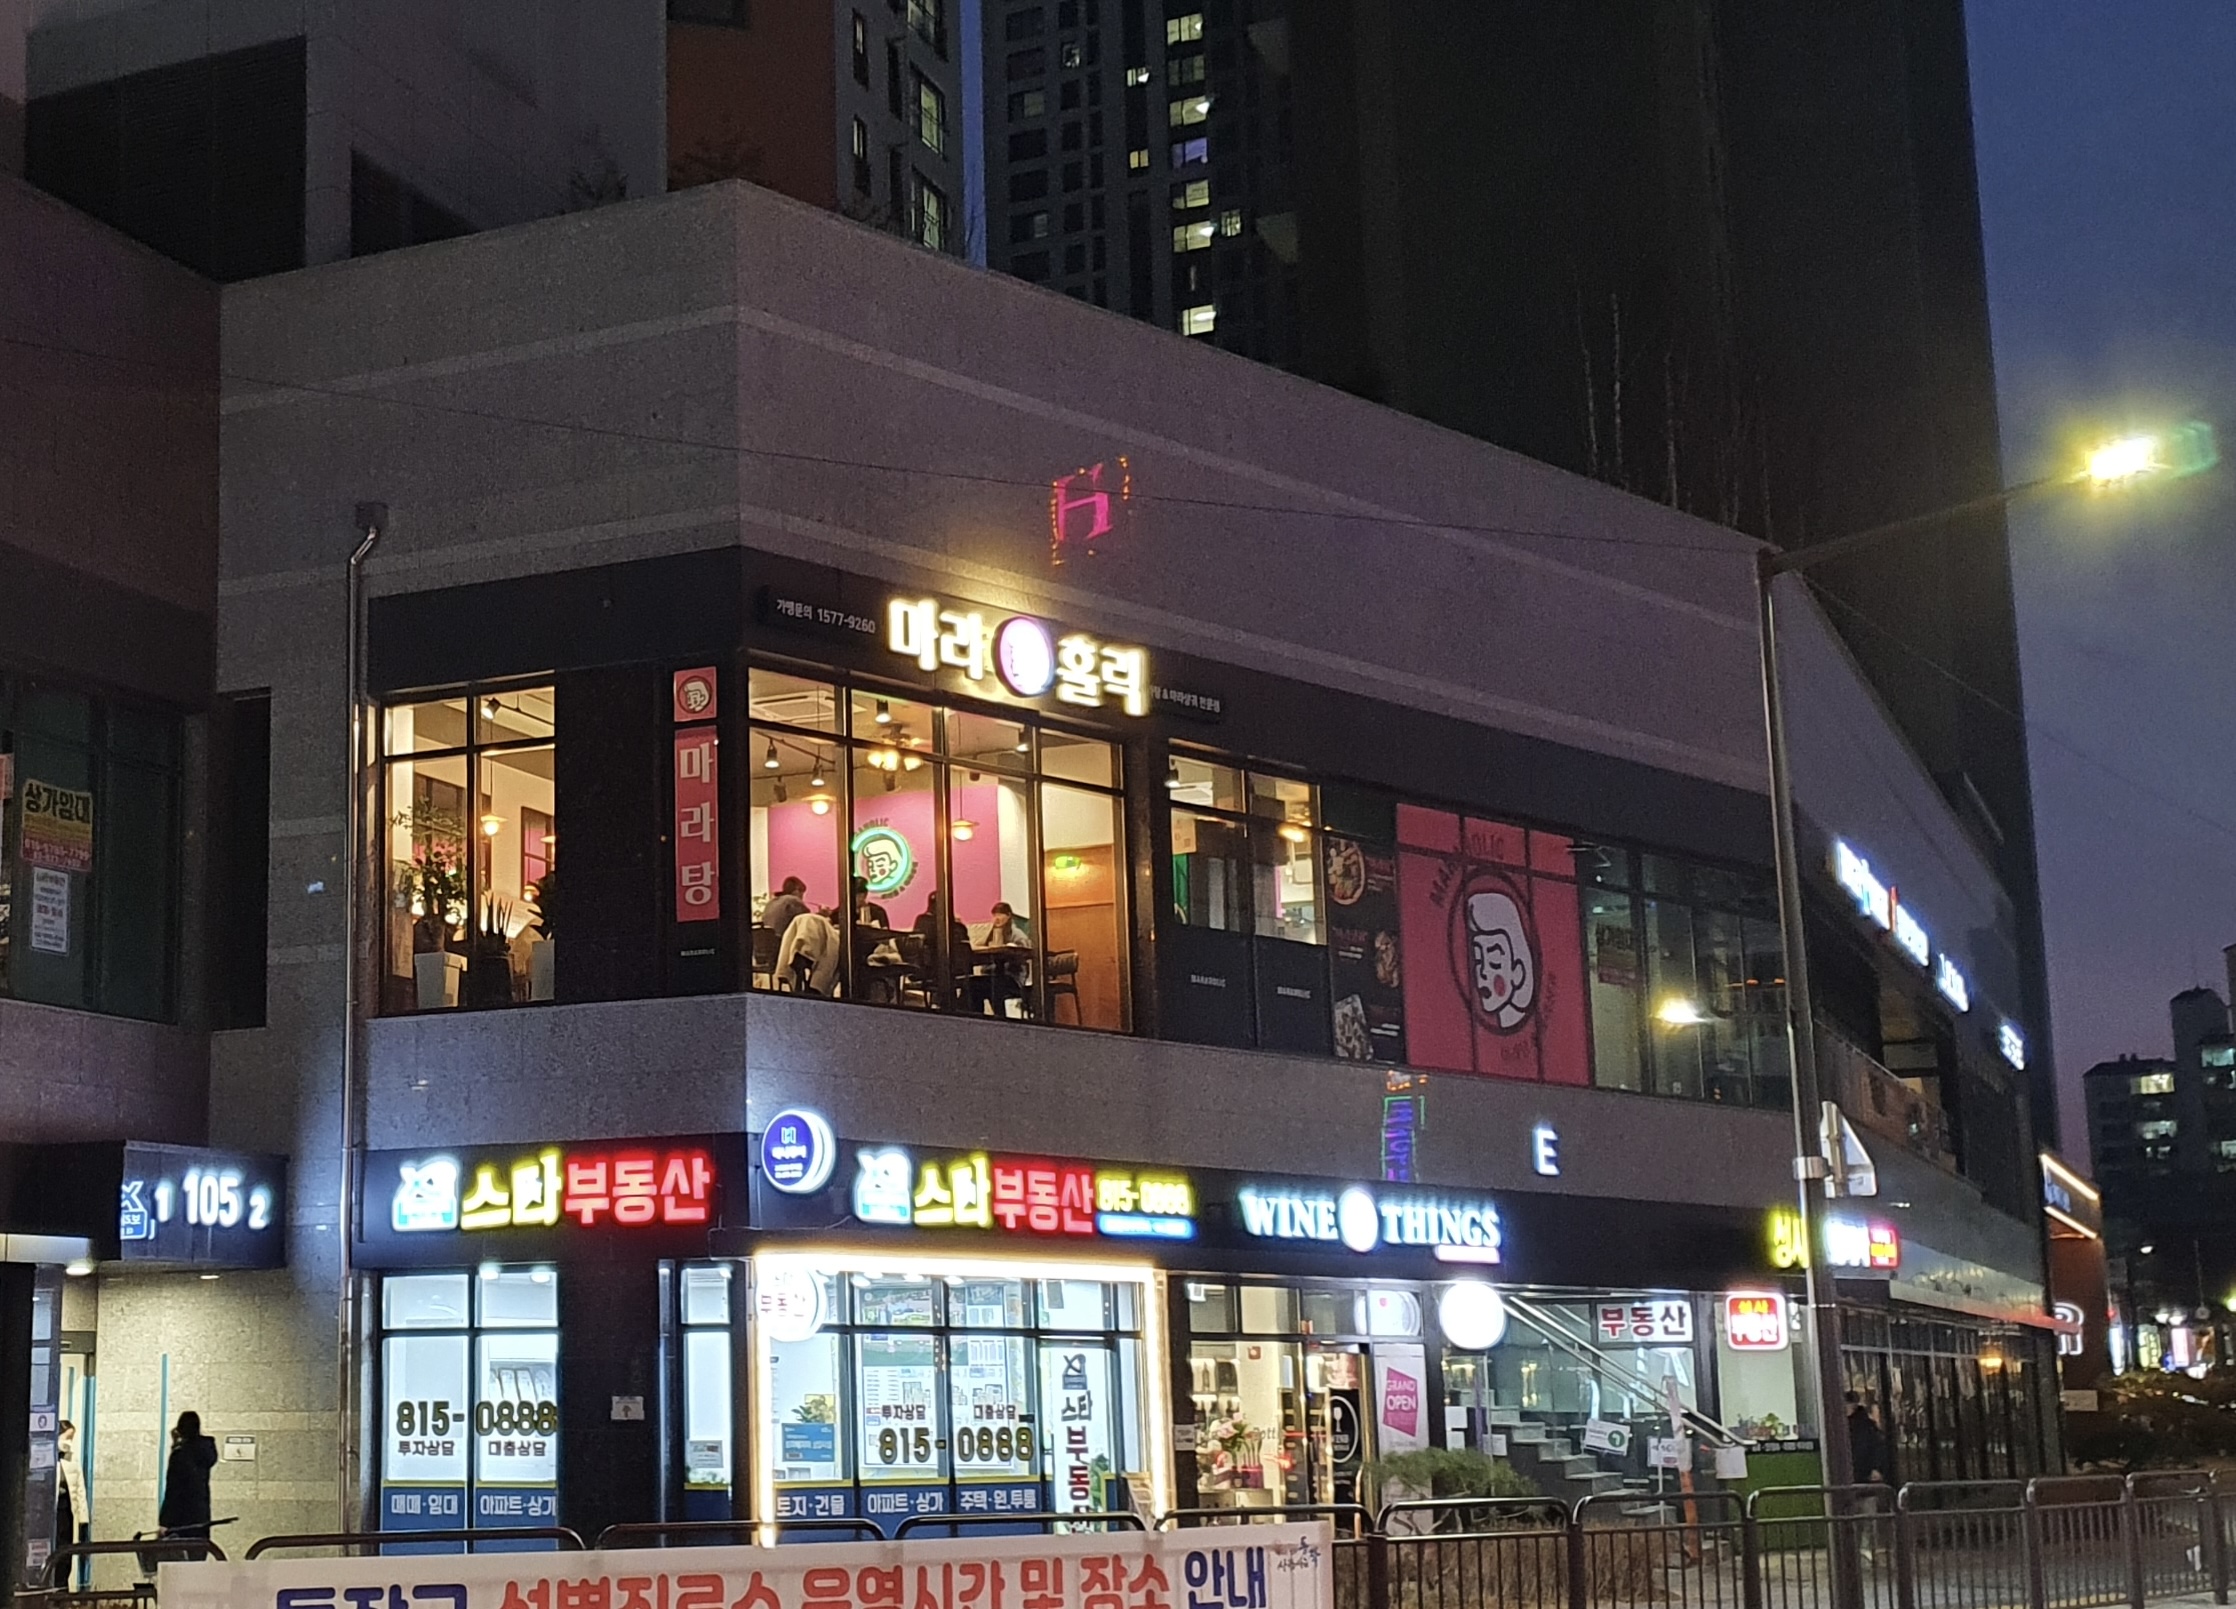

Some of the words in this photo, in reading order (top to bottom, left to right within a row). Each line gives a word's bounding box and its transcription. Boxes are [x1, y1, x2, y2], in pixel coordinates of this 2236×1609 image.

[776, 599, 813, 621] 가맹문의
[816, 606, 877, 635] 1577-9260
[889, 599, 984, 681] 마라
[1055, 636, 1150, 717] 홀릭
[25, 783, 90, 824] 상가임대
[679, 742, 714, 906] 마라탕
[1535, 1127, 1561, 1175] E
[183, 1172, 240, 1227] 105
[248, 1193, 268, 1229] 2
[1240, 1193, 1338, 1240] WINE
[1381, 1203, 1500, 1247] THINGS
[1601, 1306, 1687, 1339] 부동산
[1731, 1314, 1778, 1342] 부동산
[882, 1404, 926, 1421] 투자상담
[1386, 1394, 1417, 1411] OPEN
[398, 1440, 455, 1456] 투자상담
[488, 1440, 547, 1457] 대출상담
[1184, 1545, 1268, 1609] 안내
